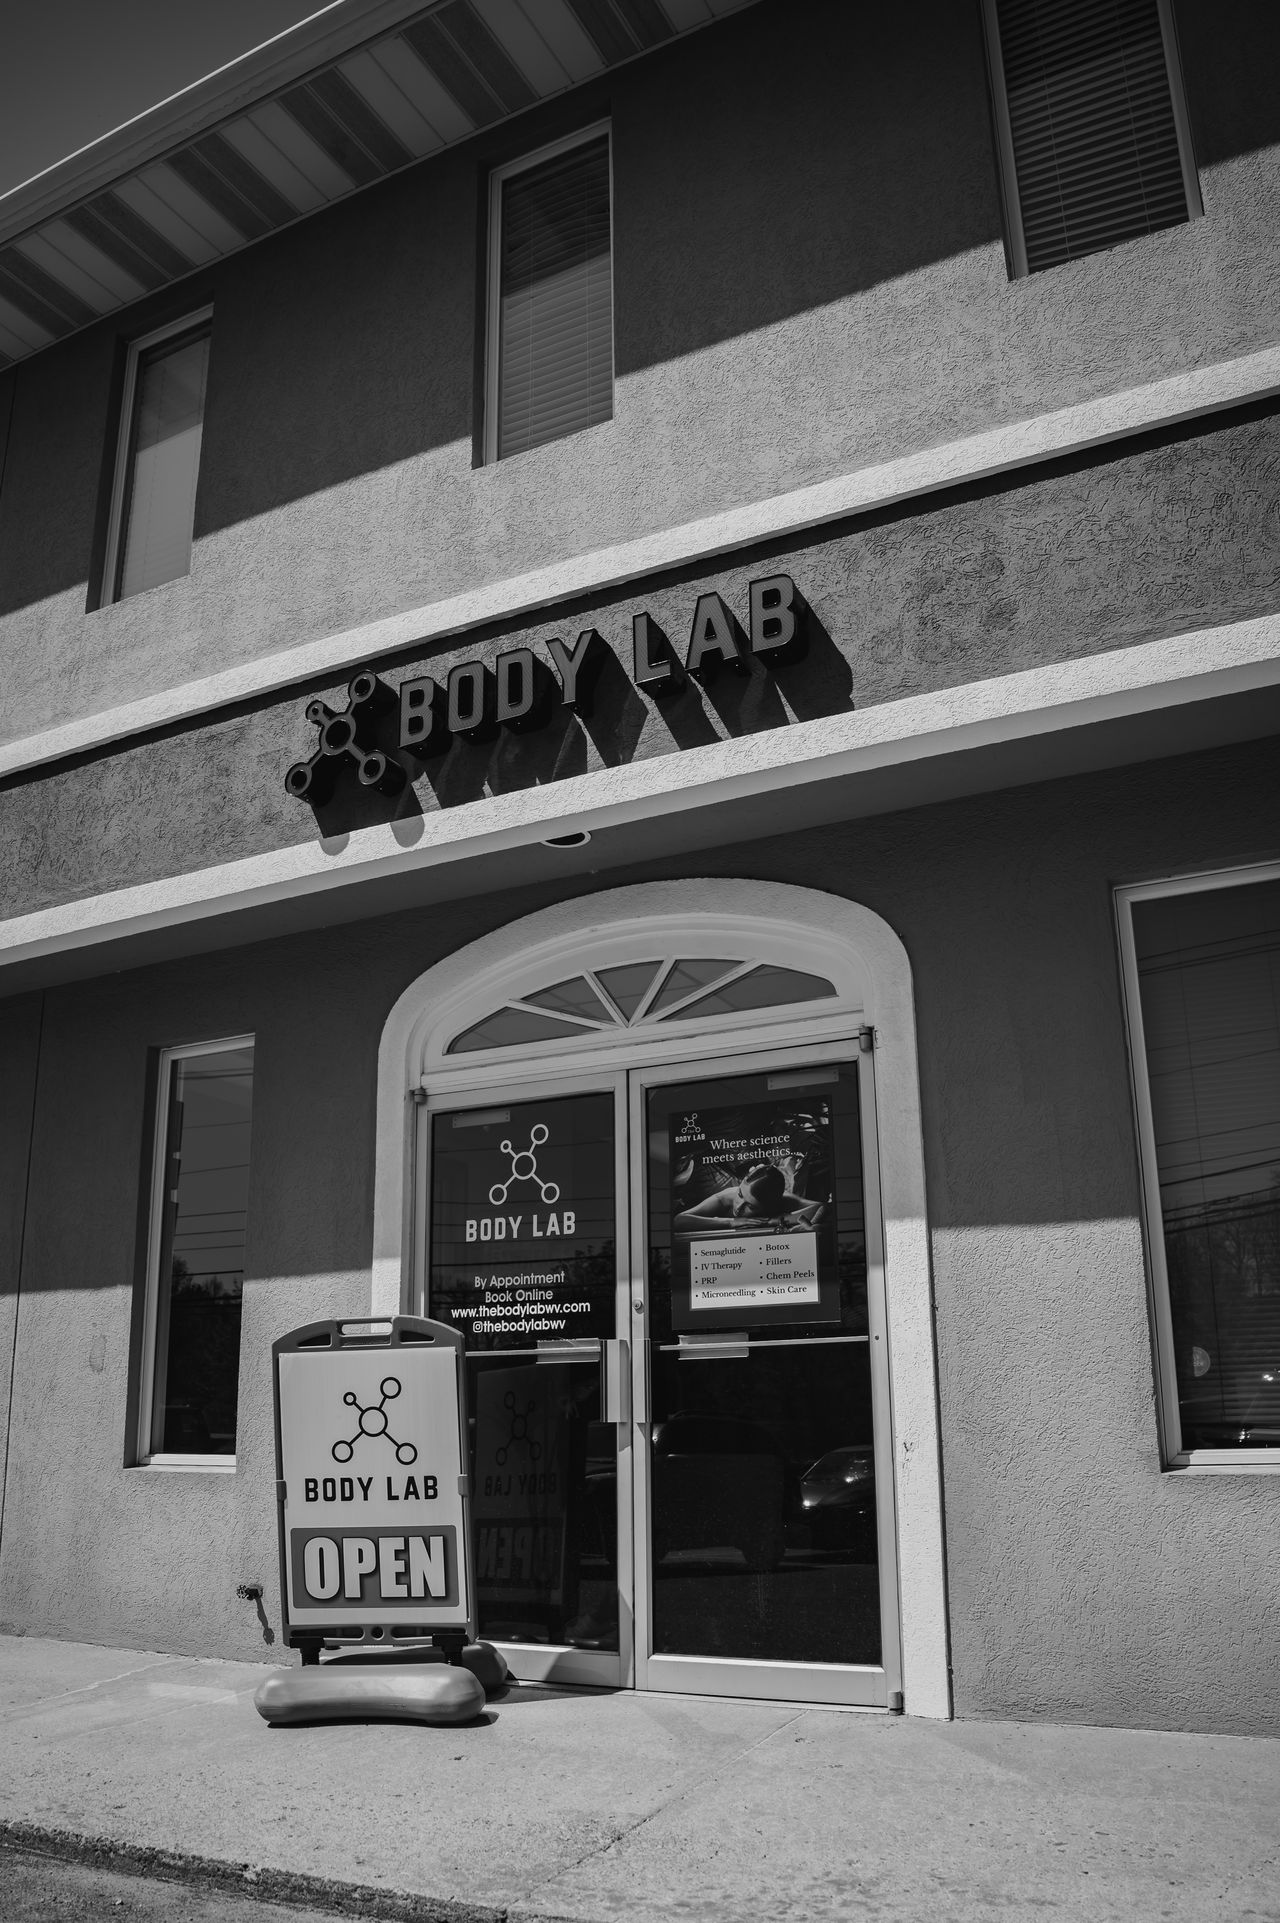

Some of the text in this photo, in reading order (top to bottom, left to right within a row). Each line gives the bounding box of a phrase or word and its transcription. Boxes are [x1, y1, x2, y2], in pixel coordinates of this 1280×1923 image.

[399, 573, 799, 752] BODY LAB
[675, 1133, 706, 1143] BODY LAB
[710, 1134, 790, 1150] Where science
[702, 1153, 735, 1164] meets
[465, 1211, 576, 1243] BODY LAB
[700, 1246, 746, 1257] Semaglutide
[765, 1243, 790, 1252] Botox
[701, 1261, 743, 1271] IV Therapy
[766, 1257, 792, 1266] Fillers
[474, 1271, 565, 1289] By Appointment
[766, 1270, 815, 1280] Chem Peels
[701, 1277, 718, 1285] PRP
[702, 1289, 756, 1299] Microneedling
[766, 1285, 807, 1295] Skin Care
[485, 1289, 554, 1303] Book Online
[451, 1302, 591, 1319] www.thebodylabwv.com
[304, 1475, 440, 1502] BODY LAB
[302, 1535, 447, 1601] OPEN
